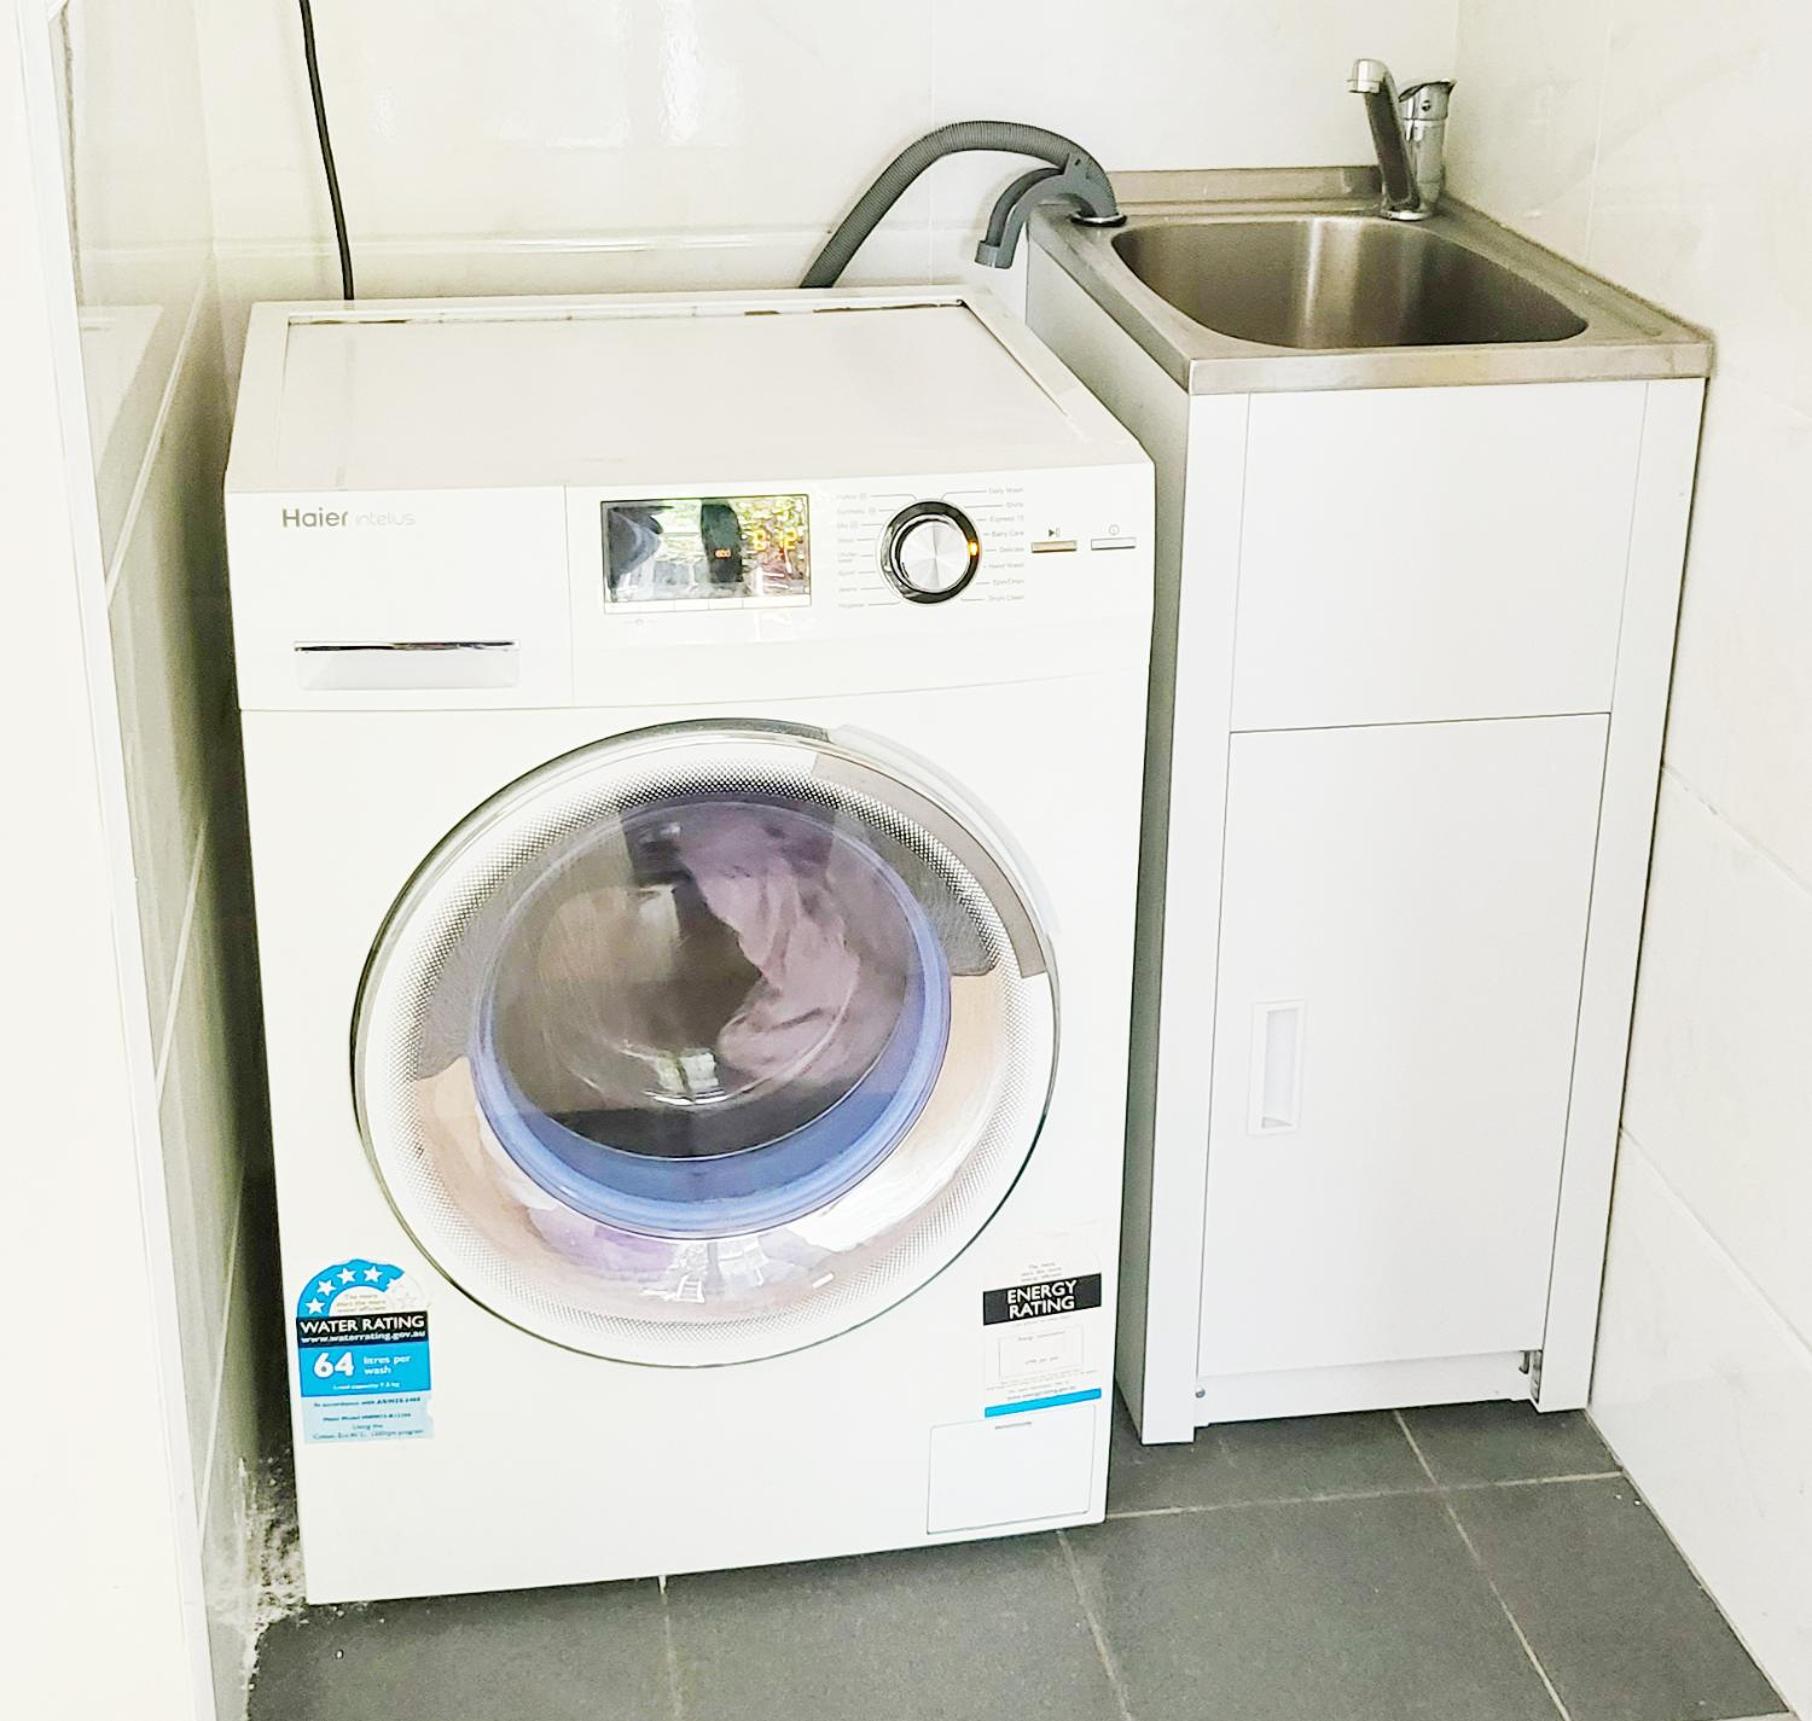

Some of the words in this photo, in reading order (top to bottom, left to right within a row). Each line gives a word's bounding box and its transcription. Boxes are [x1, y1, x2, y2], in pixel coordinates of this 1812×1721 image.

[282, 506, 348, 527] Haier
[1006, 1279, 1078, 1304] ENERGY
[1009, 1296, 1075, 1320] RATING
[300, 1319, 358, 1333] WATER
[362, 1315, 425, 1331] RATING
[300, 1330, 426, 1343] www.waterrating.gov.au
[313, 1351, 355, 1378] 64
[393, 1355, 411, 1365] per
[363, 1365, 391, 1375] wash
